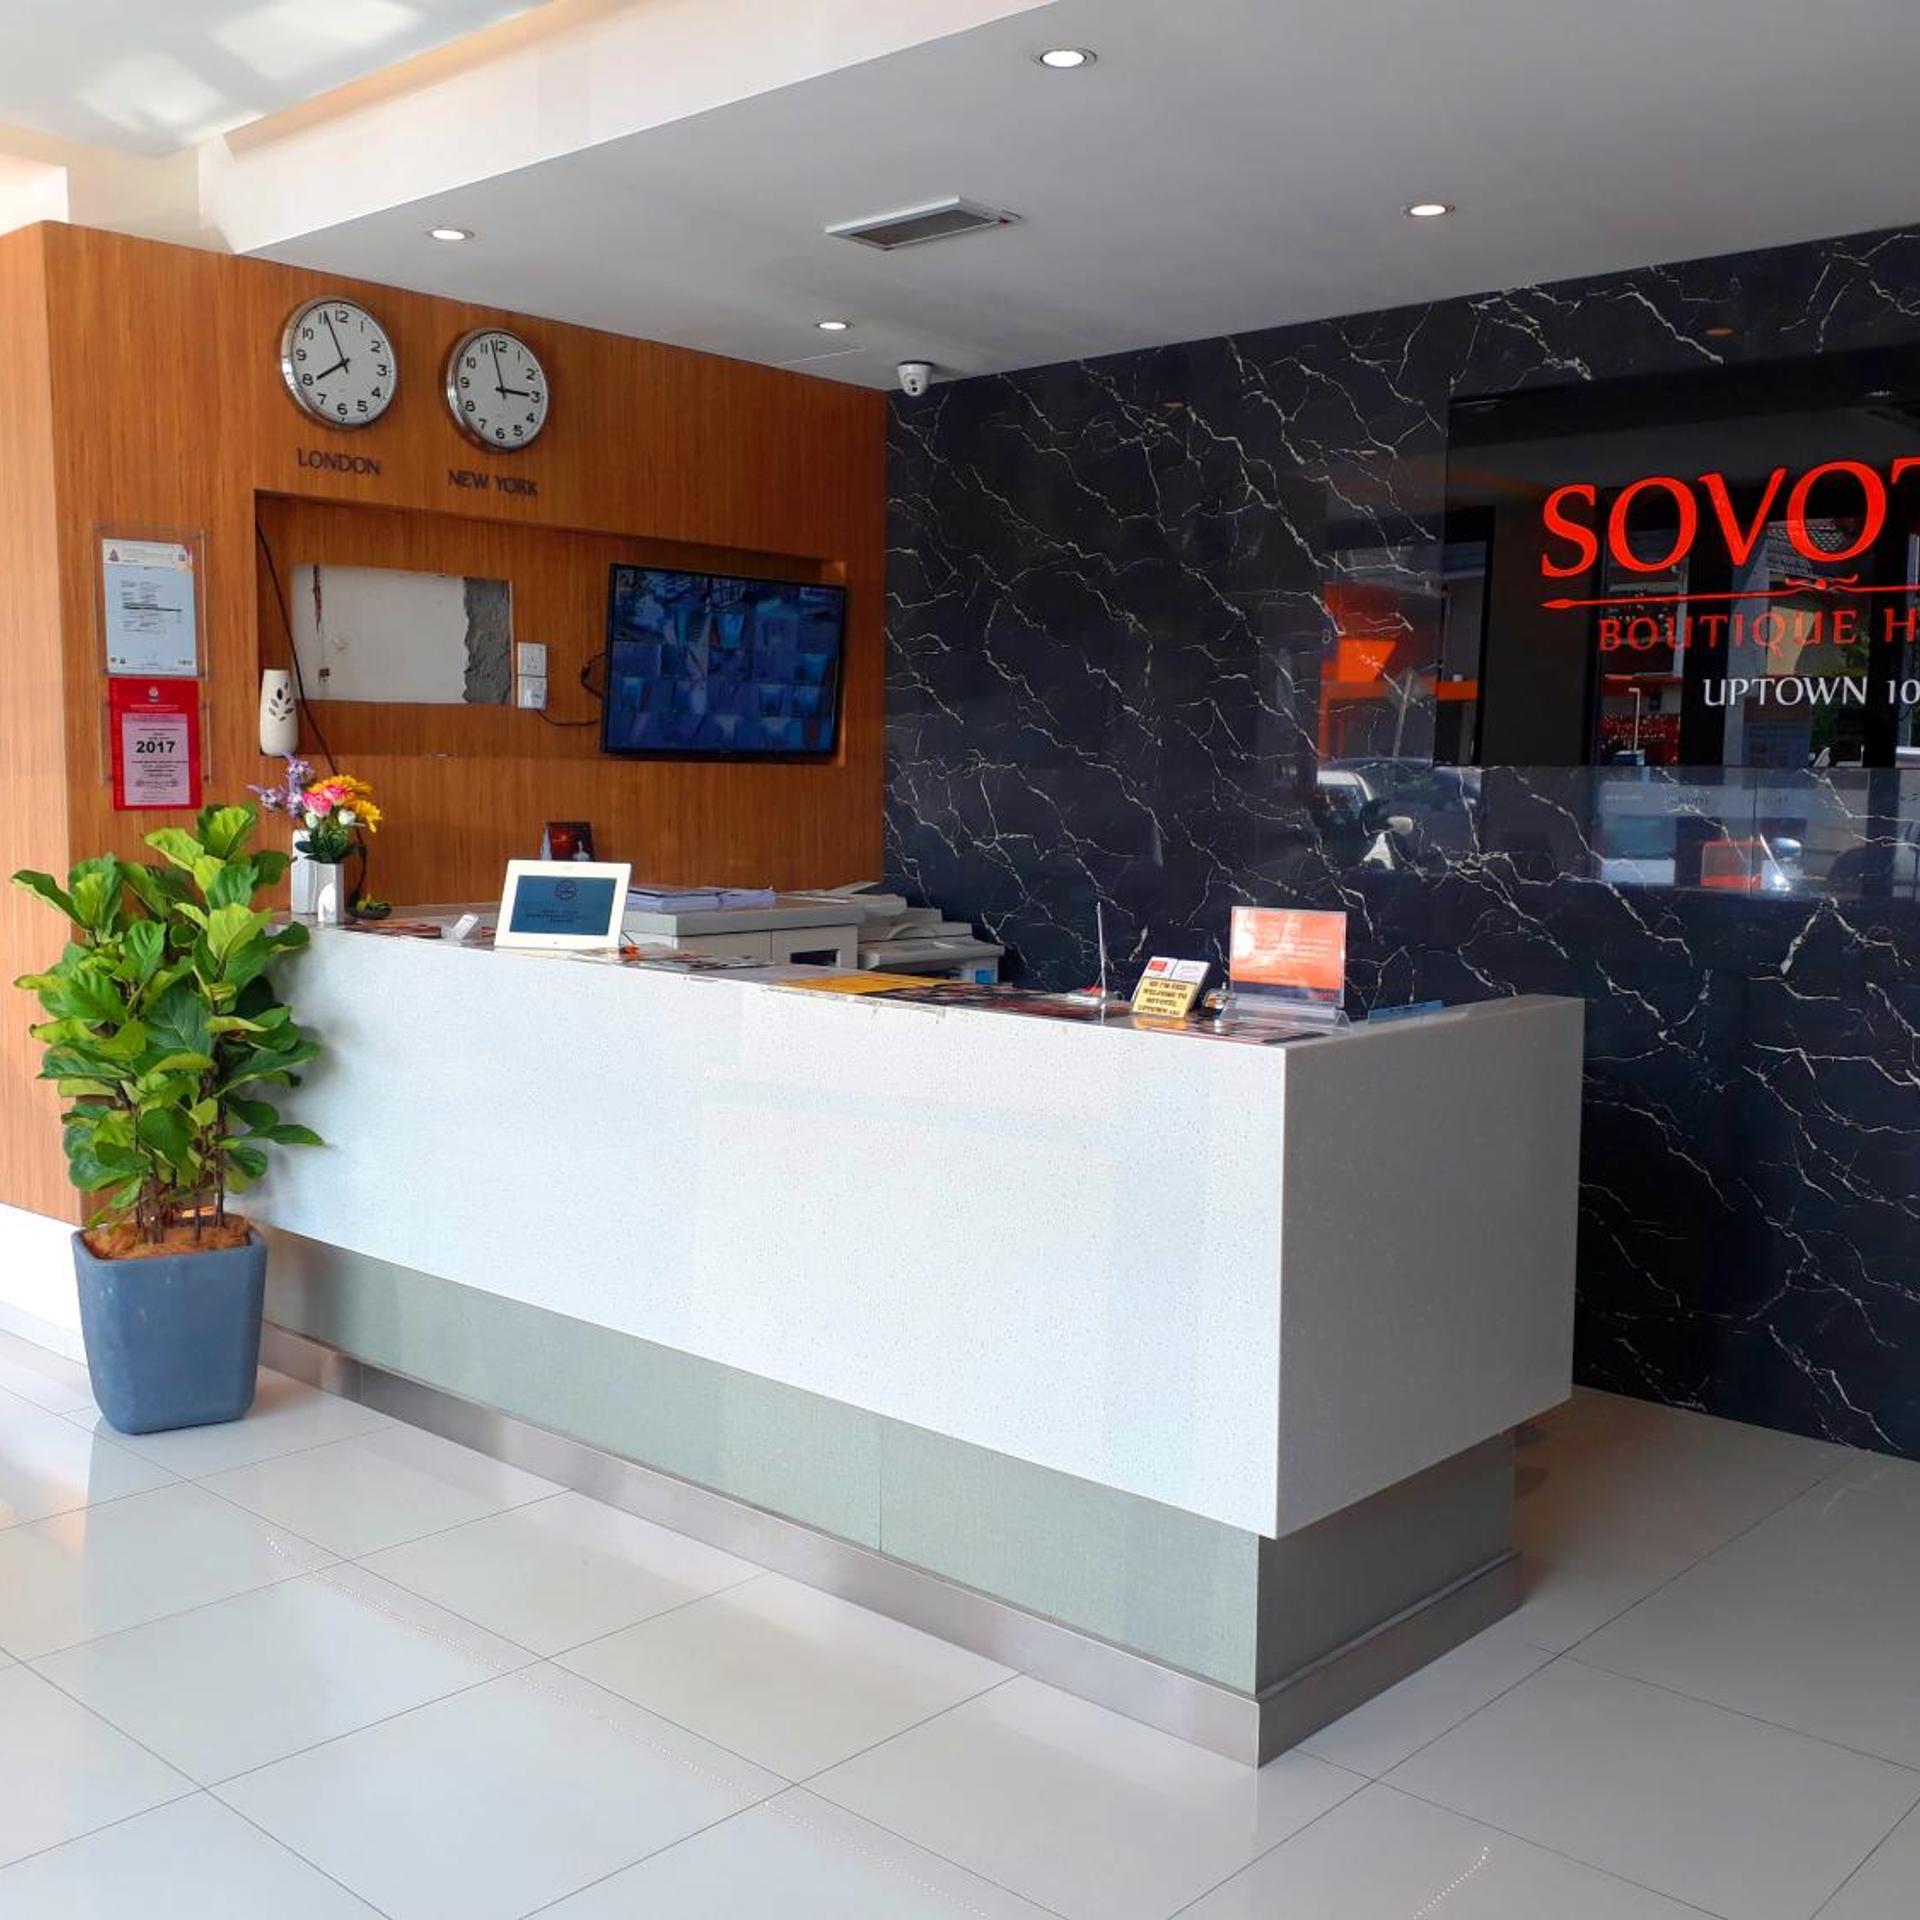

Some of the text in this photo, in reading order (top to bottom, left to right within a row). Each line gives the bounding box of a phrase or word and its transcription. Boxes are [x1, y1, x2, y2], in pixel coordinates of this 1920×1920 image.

[318, 310, 329, 325] 11
[335, 310, 350, 323] 12
[359, 320, 364, 332] 1
[302, 328, 314, 340] 10
[370, 340, 381, 352] 2
[480, 342, 488, 354] 11
[495, 341, 508, 353] 12
[296, 349, 307, 360] 9
[516, 350, 521, 362] 1
[466, 357, 476, 369] 10
[377, 364, 387, 376] 3
[526, 368, 536, 380] 2
[302, 373, 314, 386] 8
[461, 376, 470, 388] 9
[371, 386, 381, 399] 4
[532, 390, 540, 403] 3
[317, 393, 327, 406] 7
[337, 402, 348, 415] 6
[357, 400, 367, 412] 5
[465, 400, 476, 412] 8
[526, 412, 535, 423] 4
[478, 418, 486, 430] 7
[496, 428, 504, 440] 6
[514, 425, 523, 438] 5
[297, 448, 381, 476] LONDON
[447, 470, 538, 497] NEW YORK
[1598, 609, 1858, 657] BOUTIQUE
[1703, 676, 1869, 706] UPTOWN
[135, 740, 175, 753] 2017
